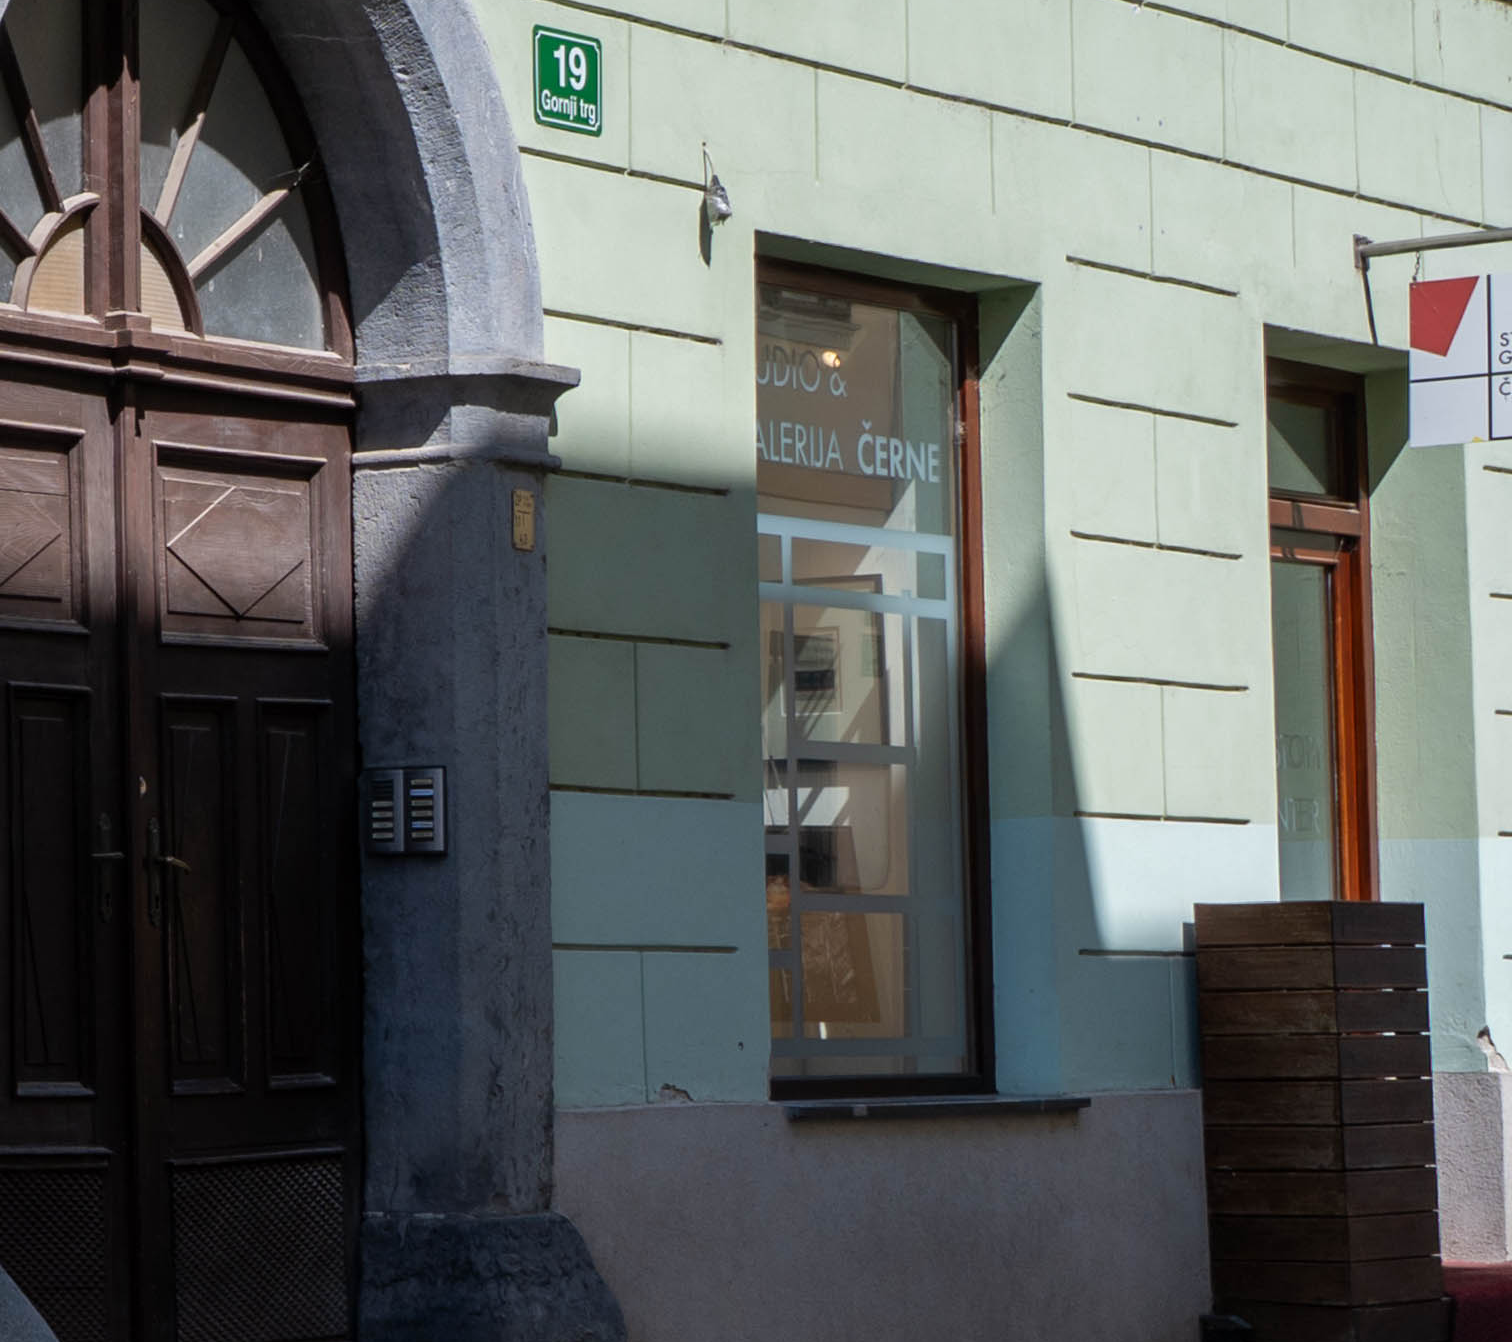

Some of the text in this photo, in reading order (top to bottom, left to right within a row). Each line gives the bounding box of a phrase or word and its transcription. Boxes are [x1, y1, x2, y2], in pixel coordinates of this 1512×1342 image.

[553, 44, 587, 91] 19
[541, 89, 596, 125] Gornji trg
[1500, 332, 1512, 347] S
[857, 419, 940, 483] ČERNE
